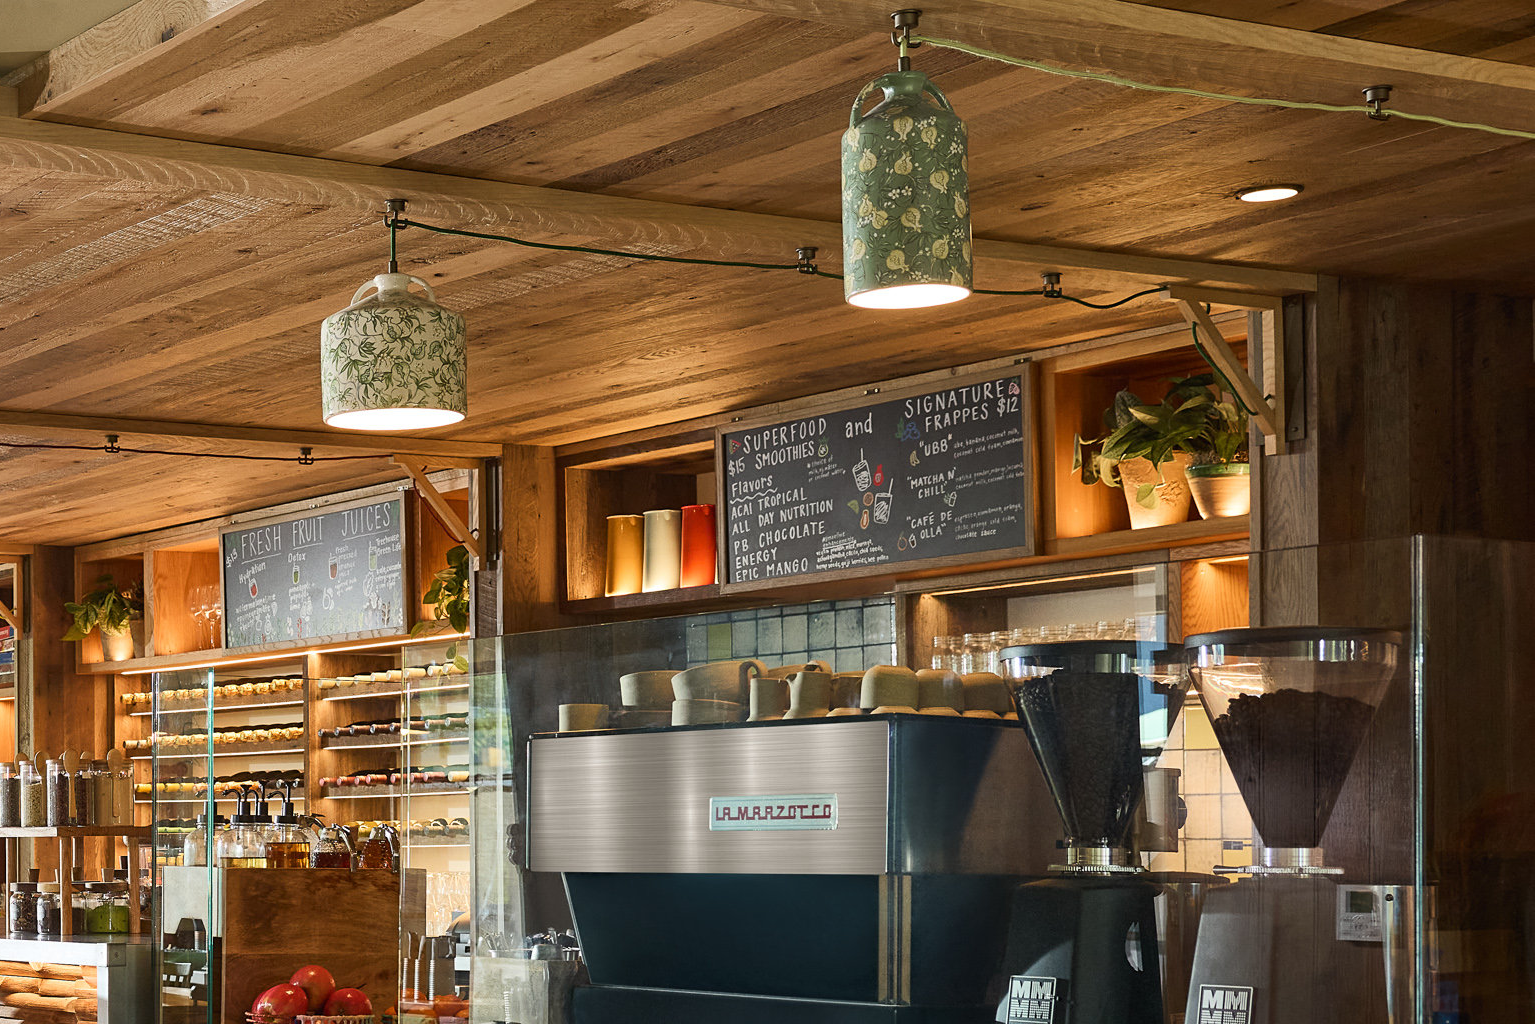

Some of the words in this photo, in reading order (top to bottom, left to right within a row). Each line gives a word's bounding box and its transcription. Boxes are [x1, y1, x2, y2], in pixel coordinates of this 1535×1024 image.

[905, 380, 1005, 418] SIGNATURE
[845, 412, 873, 438] and
[925, 403, 989, 432] FRAPPES
[997, 396, 1019, 417] $12
[743, 418, 826, 454] SUPERFOOD
[729, 457, 745, 476] $15
[755, 440, 815, 470] SMOOTHIES
[731, 475, 773, 498] Flavors
[731, 502, 753, 520] ACAI
[758, 488, 807, 511] TROPICAL
[732, 520, 751, 536] ALL
[758, 512, 775, 527] DAY
[780, 499, 833, 522] NUTRITION
[941, 510, 953, 522] DE
[241, 525, 281, 560] FRESH
[293, 516, 325, 546] FRUIT
[341, 502, 391, 536] JUICES
[734, 539, 749, 555] PB
[759, 520, 825, 548] CHOCOLATE
[225, 548, 238, 568] $13
[288, 552, 307, 562] Detox
[736, 547, 777, 570] ENERGY
[736, 568, 759, 582] EPIC
[767, 558, 809, 576] MANGO
[239, 562, 265, 584] Hydration
